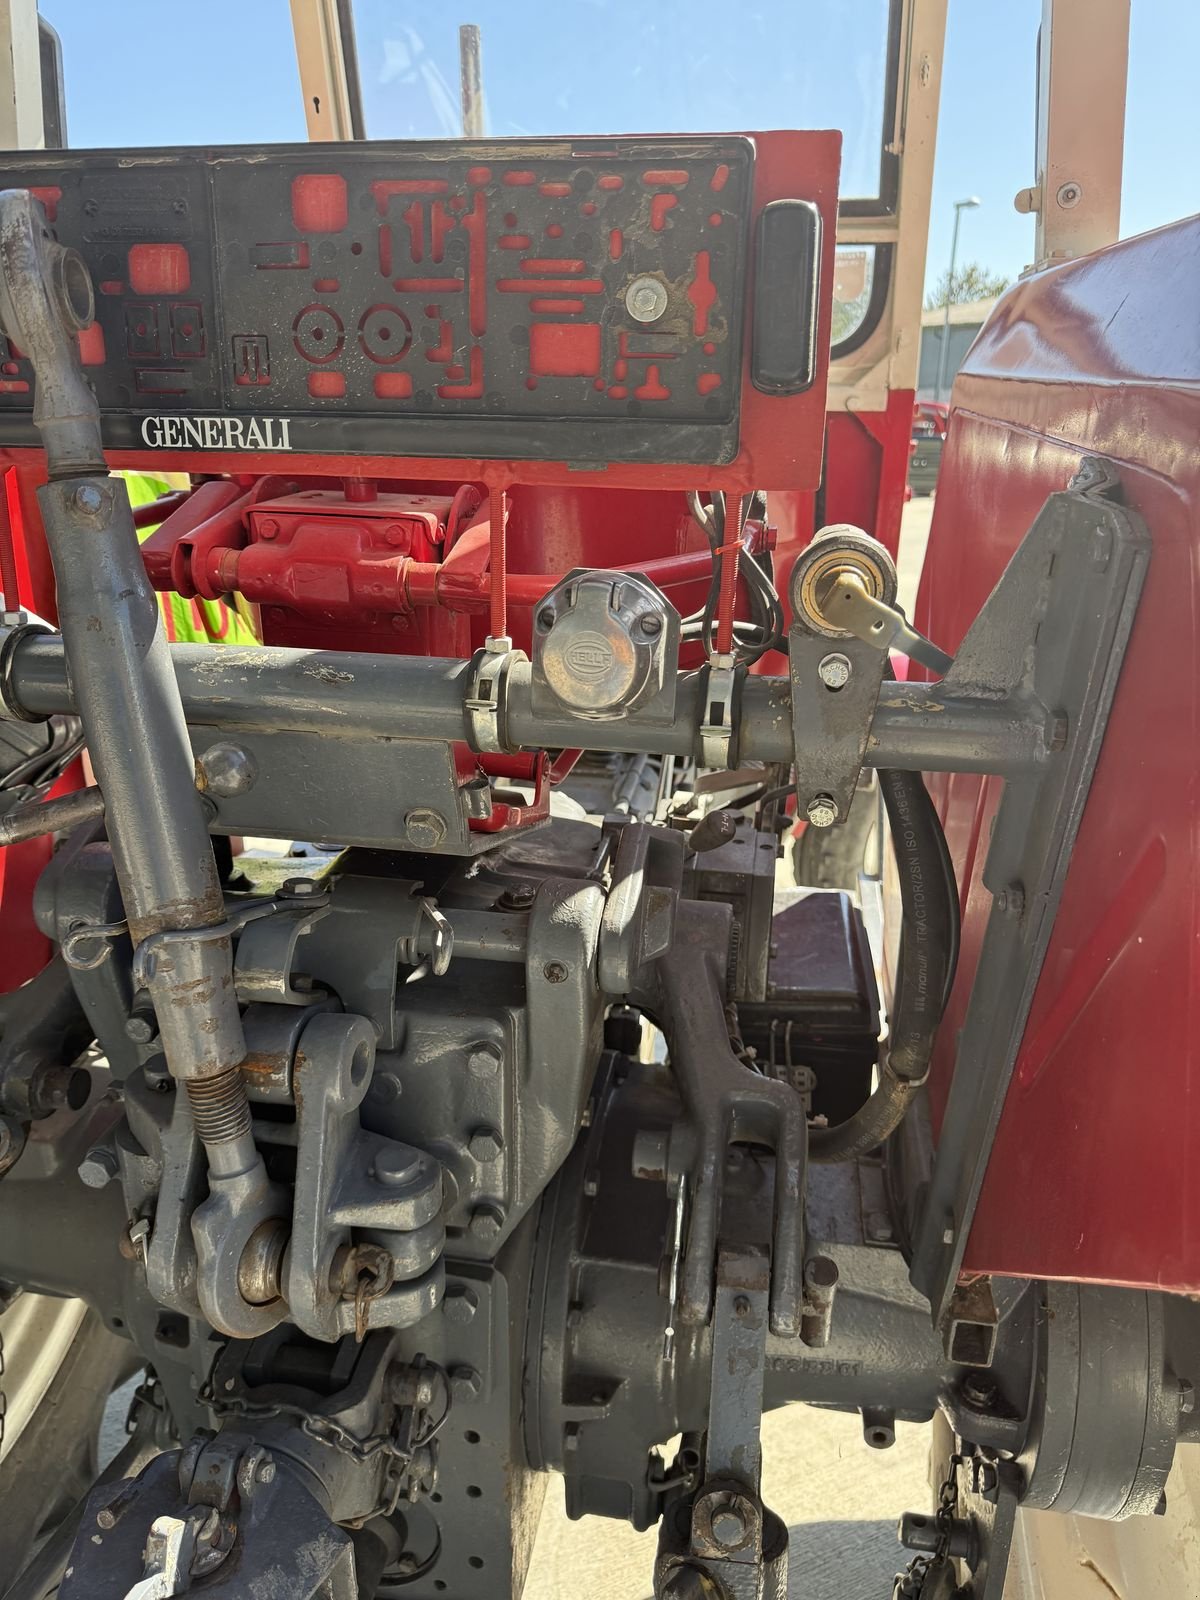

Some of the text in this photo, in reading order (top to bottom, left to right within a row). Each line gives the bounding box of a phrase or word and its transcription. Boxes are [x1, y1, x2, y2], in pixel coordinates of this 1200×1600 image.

[141, 416, 292, 450] GENERALI
[891, 781, 906, 799] EN
[897, 800, 913, 828] 1436
[903, 830, 918, 851] ISO
[909, 857, 927, 944] TRACTOR/2SN
